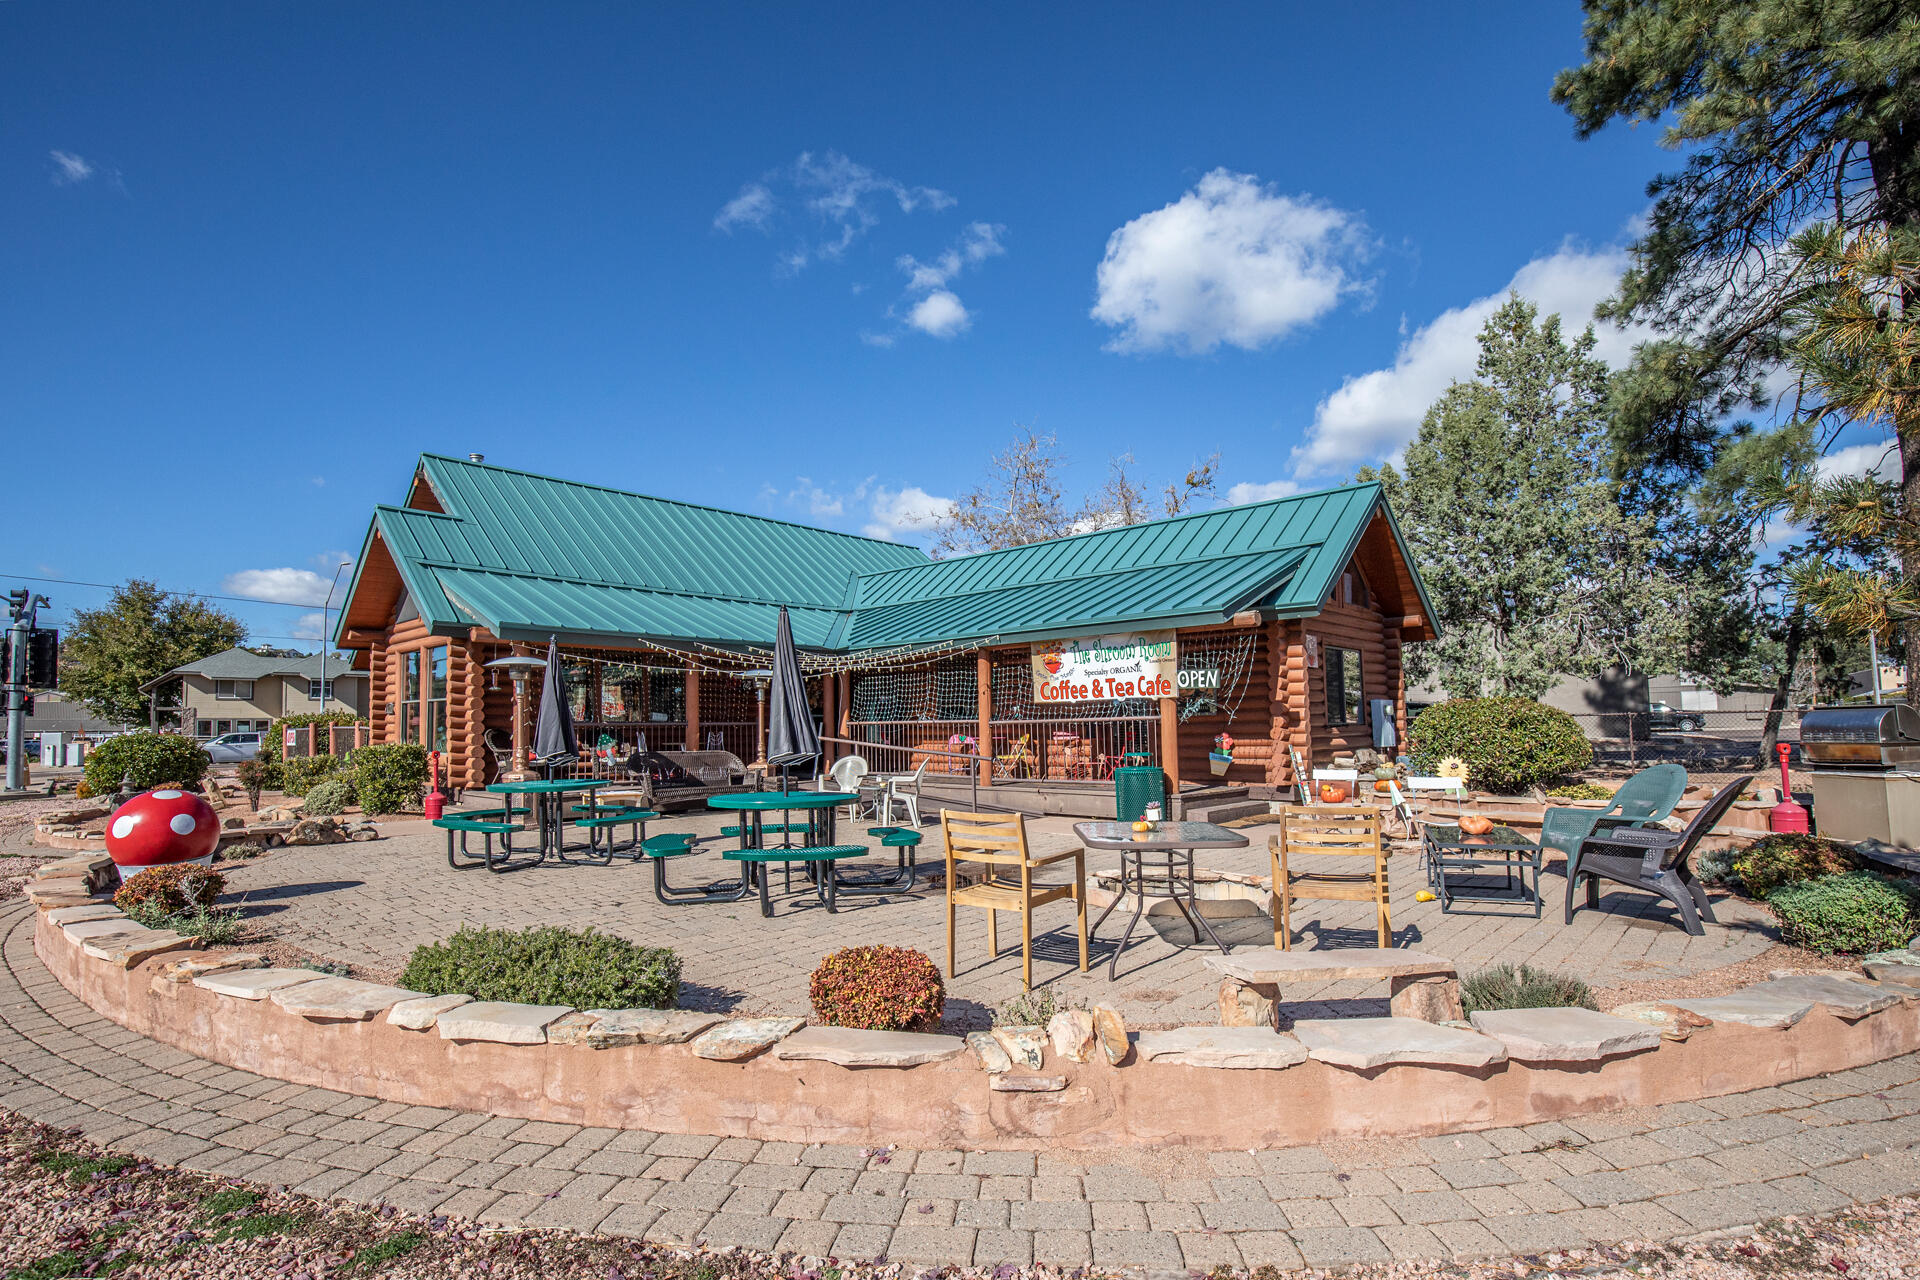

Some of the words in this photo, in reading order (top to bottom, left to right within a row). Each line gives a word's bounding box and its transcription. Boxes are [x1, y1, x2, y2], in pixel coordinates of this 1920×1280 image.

[1070, 640, 1090, 664] The
[1093, 639, 1135, 663] Shroom
[1138, 637, 1171, 662] Room
[1084, 668, 1108, 677] Specialty
[1177, 670, 1218, 687] OPEN
[1040, 679, 1088, 700] Coffee
[1092, 678, 1104, 698] &
[1105, 678, 1134, 697] Tea
[1137, 673, 1171, 696] Cafe
